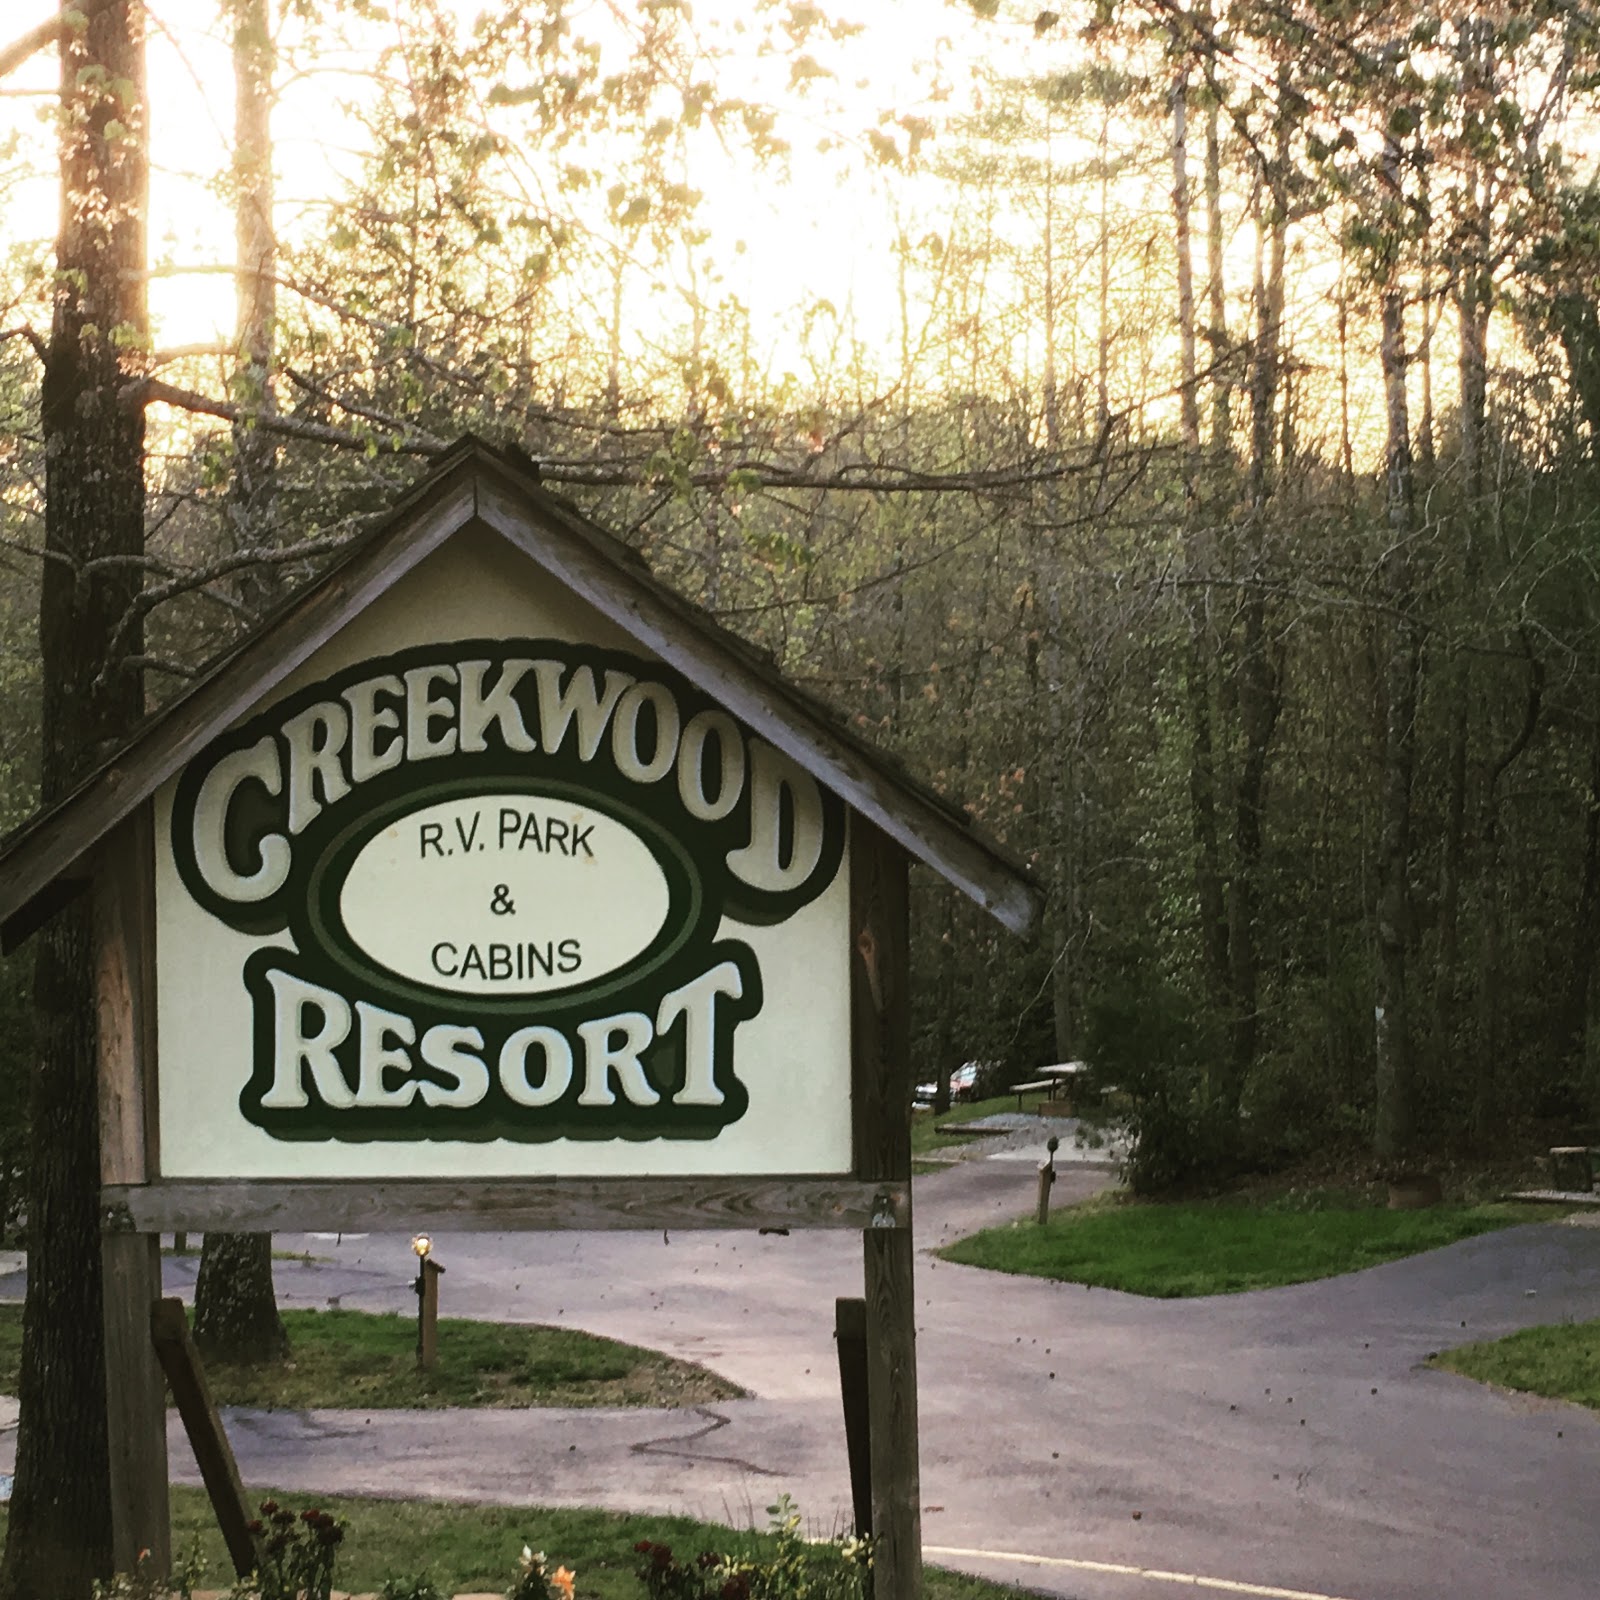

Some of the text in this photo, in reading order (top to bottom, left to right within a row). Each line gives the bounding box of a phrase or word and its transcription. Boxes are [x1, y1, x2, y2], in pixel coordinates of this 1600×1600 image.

[193, 658, 825, 903] CREEKWOOD
[420, 808, 596, 859] R.V. PARK
[490, 884, 517, 916] &
[431, 939, 583, 981] CABINS
[260, 960, 743, 1109] RESORT
